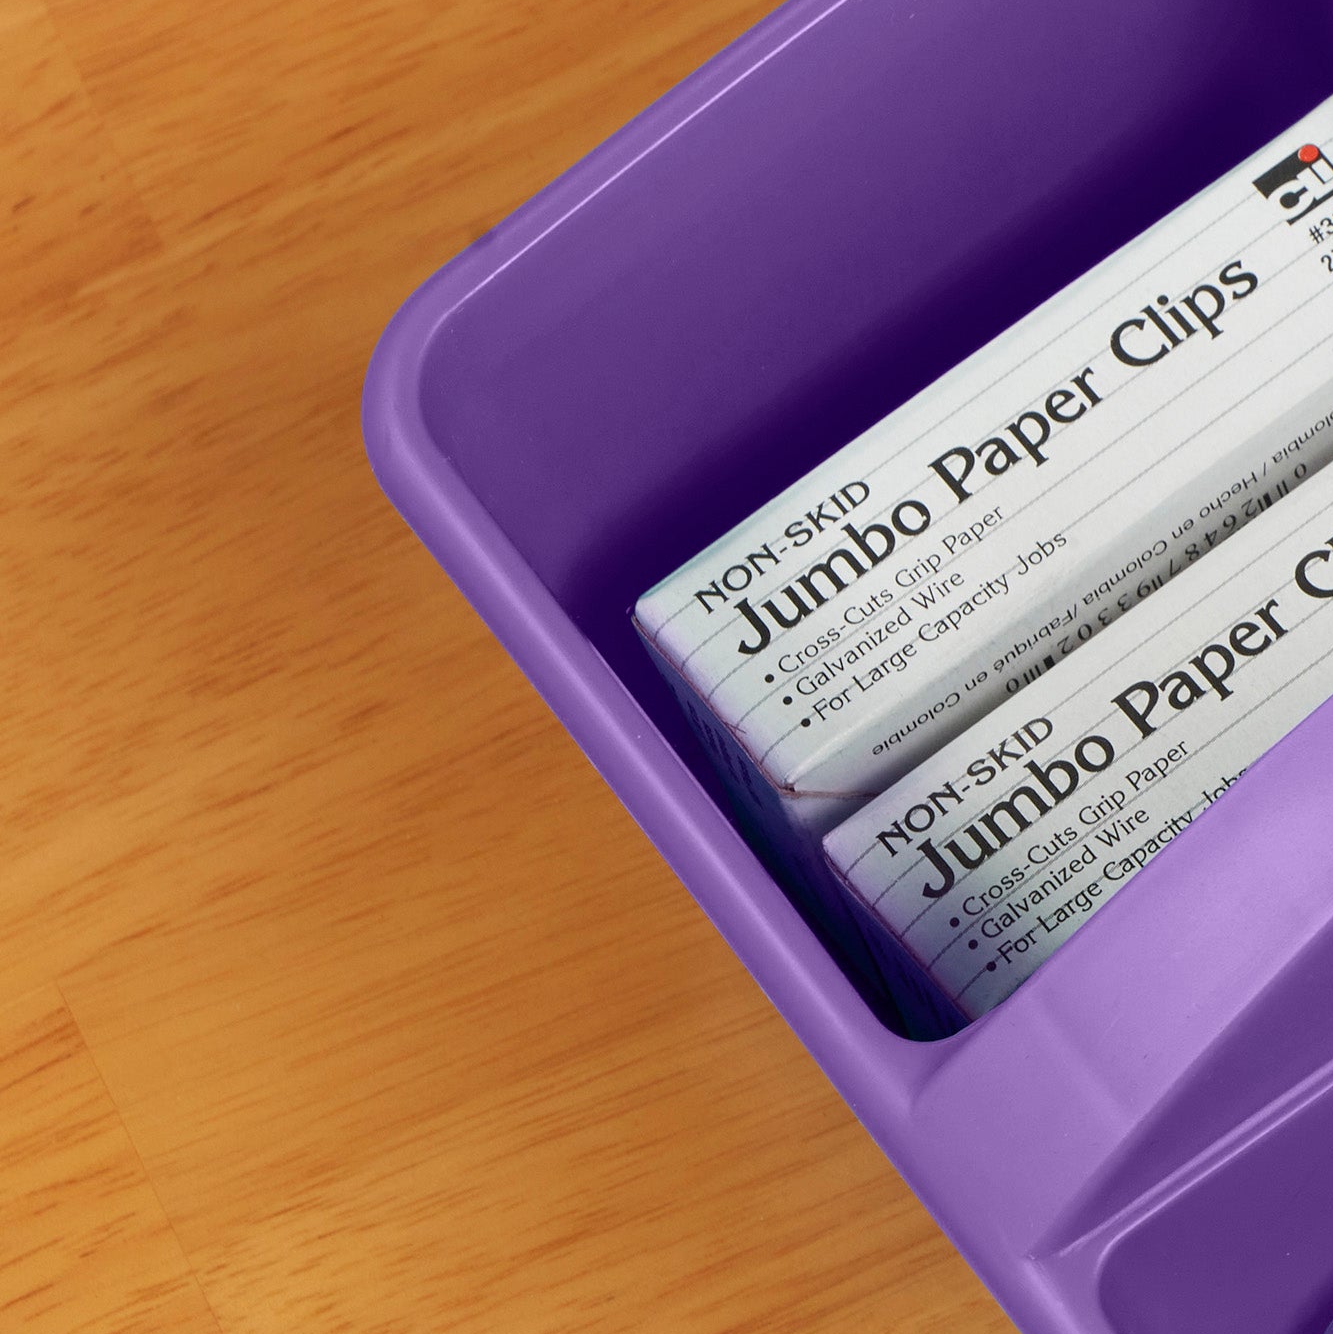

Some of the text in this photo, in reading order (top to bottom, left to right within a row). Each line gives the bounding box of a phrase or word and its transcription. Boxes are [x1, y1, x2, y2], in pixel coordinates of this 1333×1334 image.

[733, 260, 1259, 656] Jumbo Paper Clips
[1199, 471, 1258, 519] Hecho
[694, 481, 871, 614] NON-SKID
[778, 506, 1005, 674] Cross-Cuts Grip Paper
[1082, 540, 1168, 606] Colombia
[1172, 519, 1195, 540] en
[795, 573, 965, 696] Galvanized Wire
[812, 533, 1068, 723] For Large Capacity Jobs
[964, 669, 988, 692] en
[872, 691, 961, 756] Colombie
[876, 717, 1054, 857] NON-SKID
[916, 735, 1115, 899] Jumbo
[1110, 599, 1289, 739] Paper
[962, 740, 1190, 916] Cross-Cuts Grip Paper
[981, 807, 1150, 938] Galvanized Wire
[997, 928, 1039, 964] For
[1036, 880, 1103, 933] Large
[1102, 810, 1193, 881] Capacity
